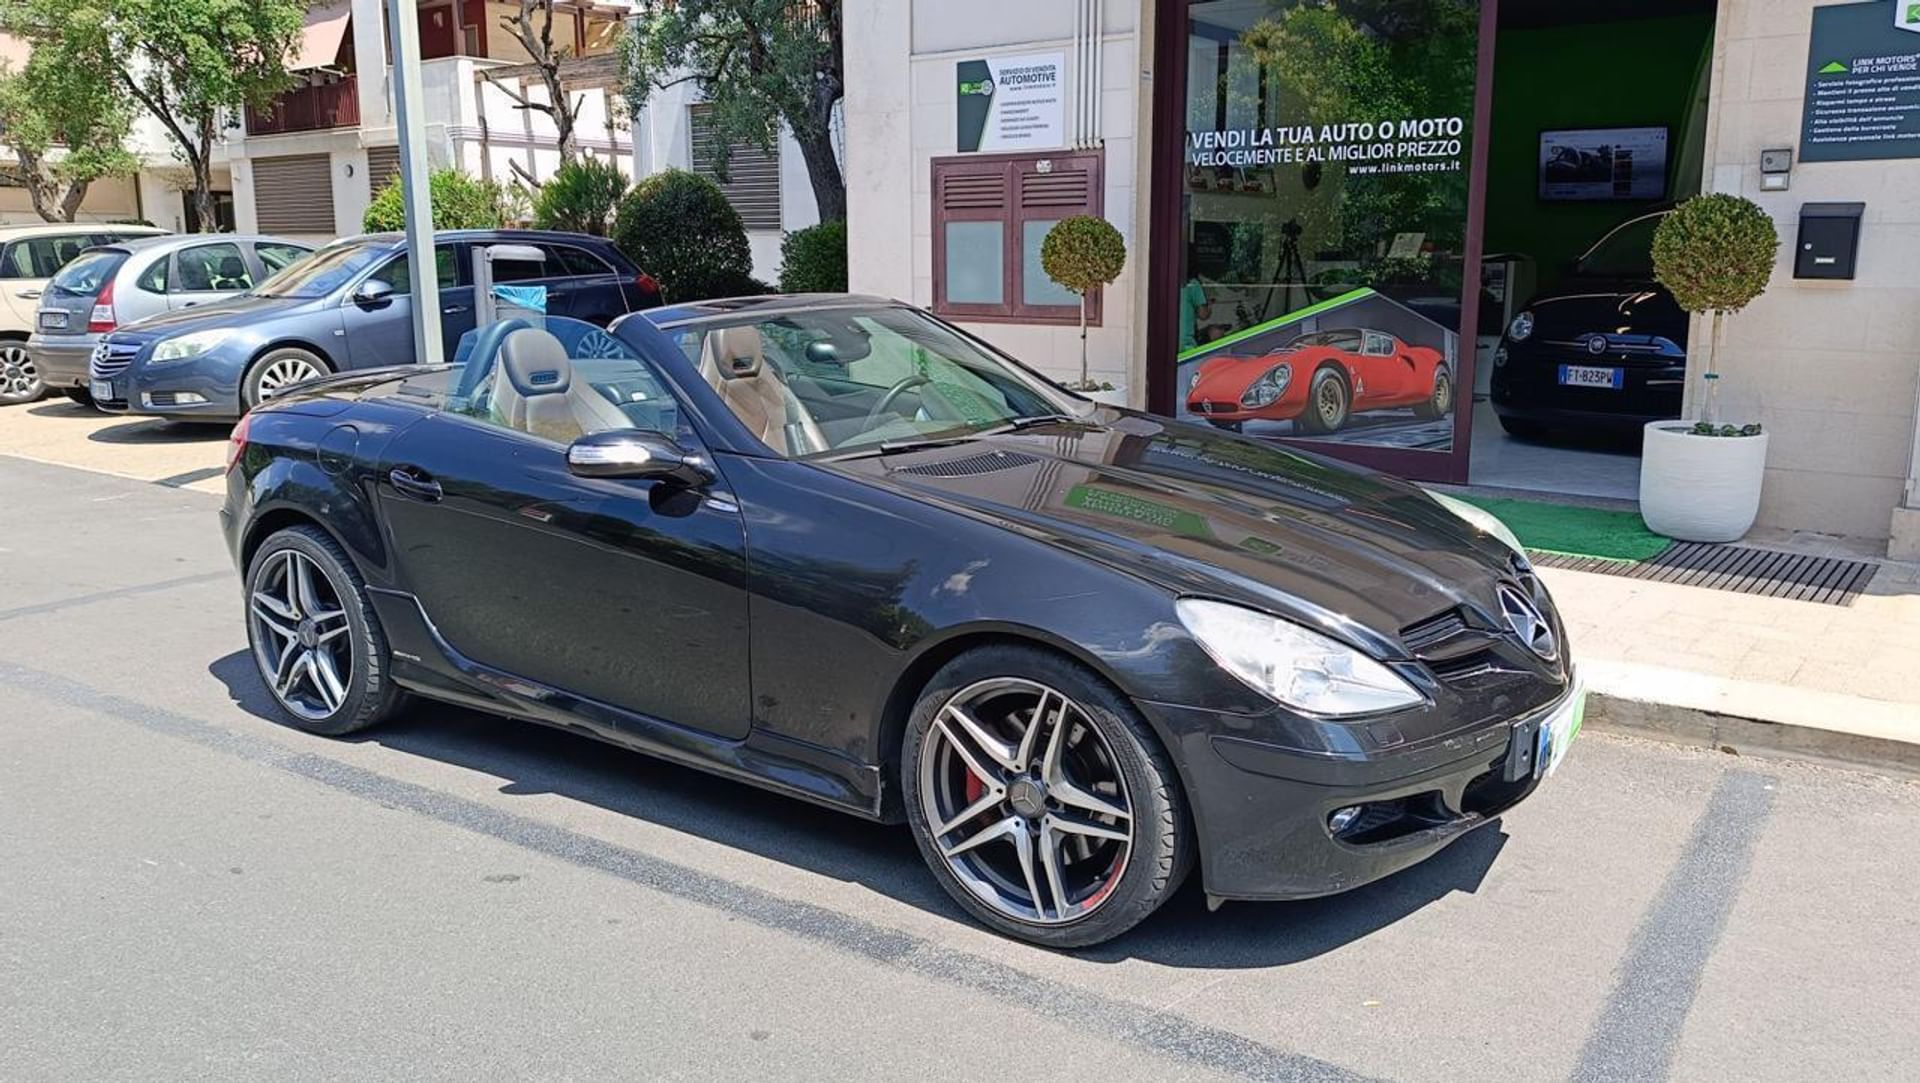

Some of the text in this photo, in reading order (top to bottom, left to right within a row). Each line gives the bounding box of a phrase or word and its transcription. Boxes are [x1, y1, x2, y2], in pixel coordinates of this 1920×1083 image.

[1853, 54, 1916, 66] LINK MOTORS
[1852, 62, 1917, 74] PER CHI VENDE
[1000, 72, 1056, 85] AUTOMOTIVE
[1192, 117, 1463, 149] VENDI LA TUA AUTO O MOTO
[1192, 139, 1462, 167] VELOCEMENTE E AL MIGLIOR PREZZO
[1348, 160, 1461, 174] www.linkmotors.it
